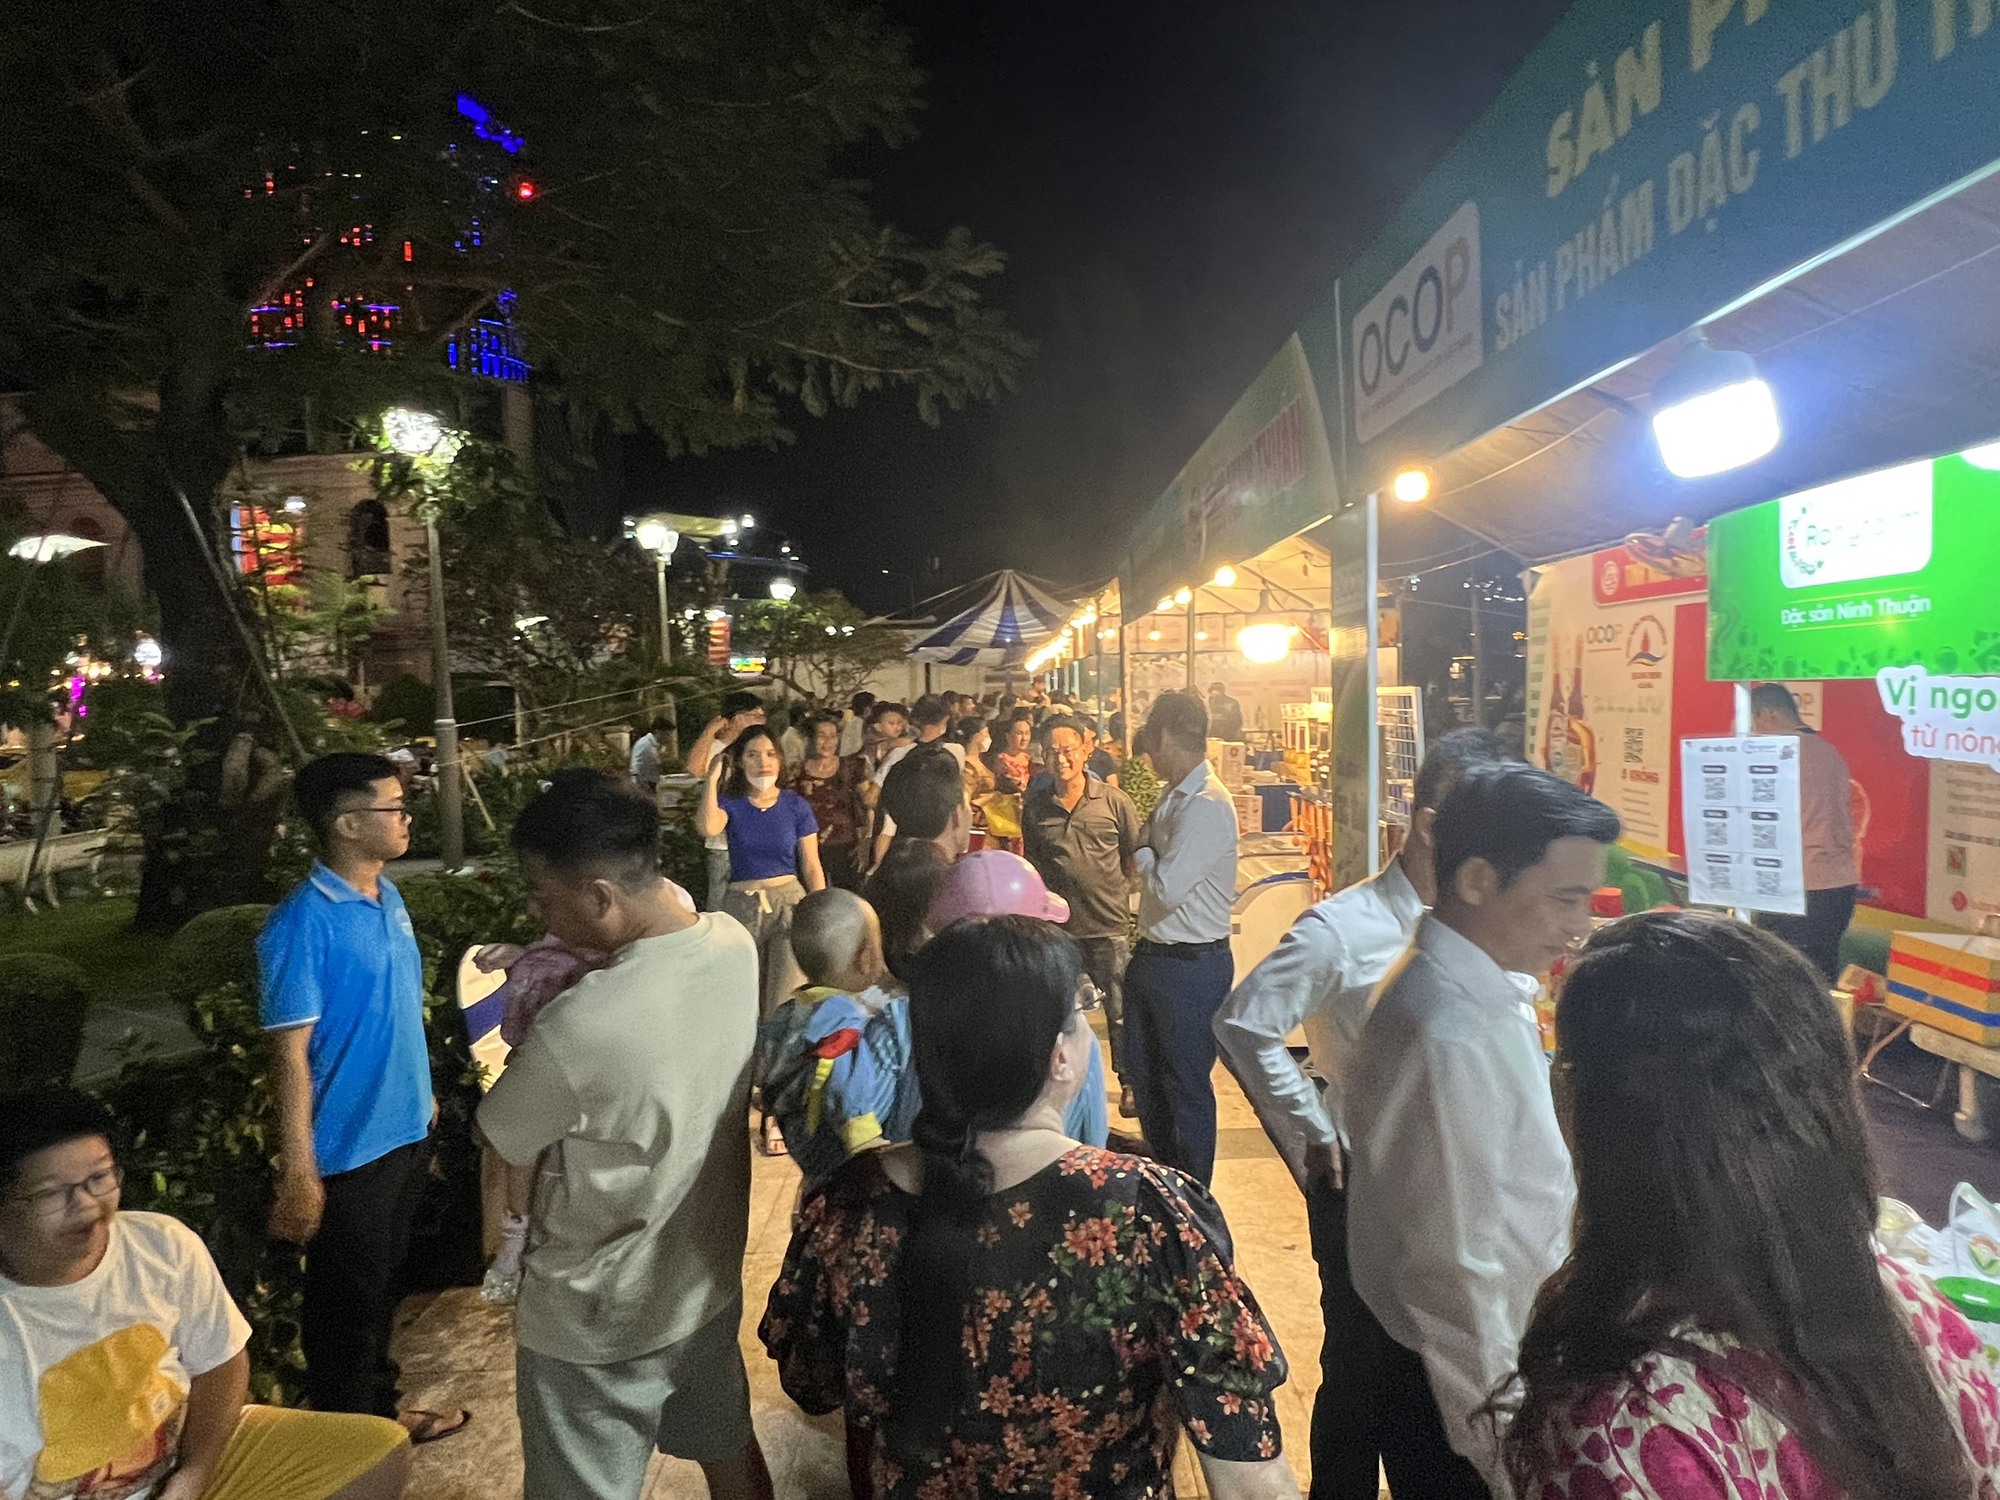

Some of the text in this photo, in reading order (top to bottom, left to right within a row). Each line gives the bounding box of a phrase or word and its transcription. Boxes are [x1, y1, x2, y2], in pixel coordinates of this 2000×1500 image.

[1359, 235, 1470, 397] OCOP
[1781, 594, 1931, 627] Đặc sản Ninh Thuận
[1885, 675, 1998, 719] Vị ngo
[1911, 723, 1939, 748] từ
